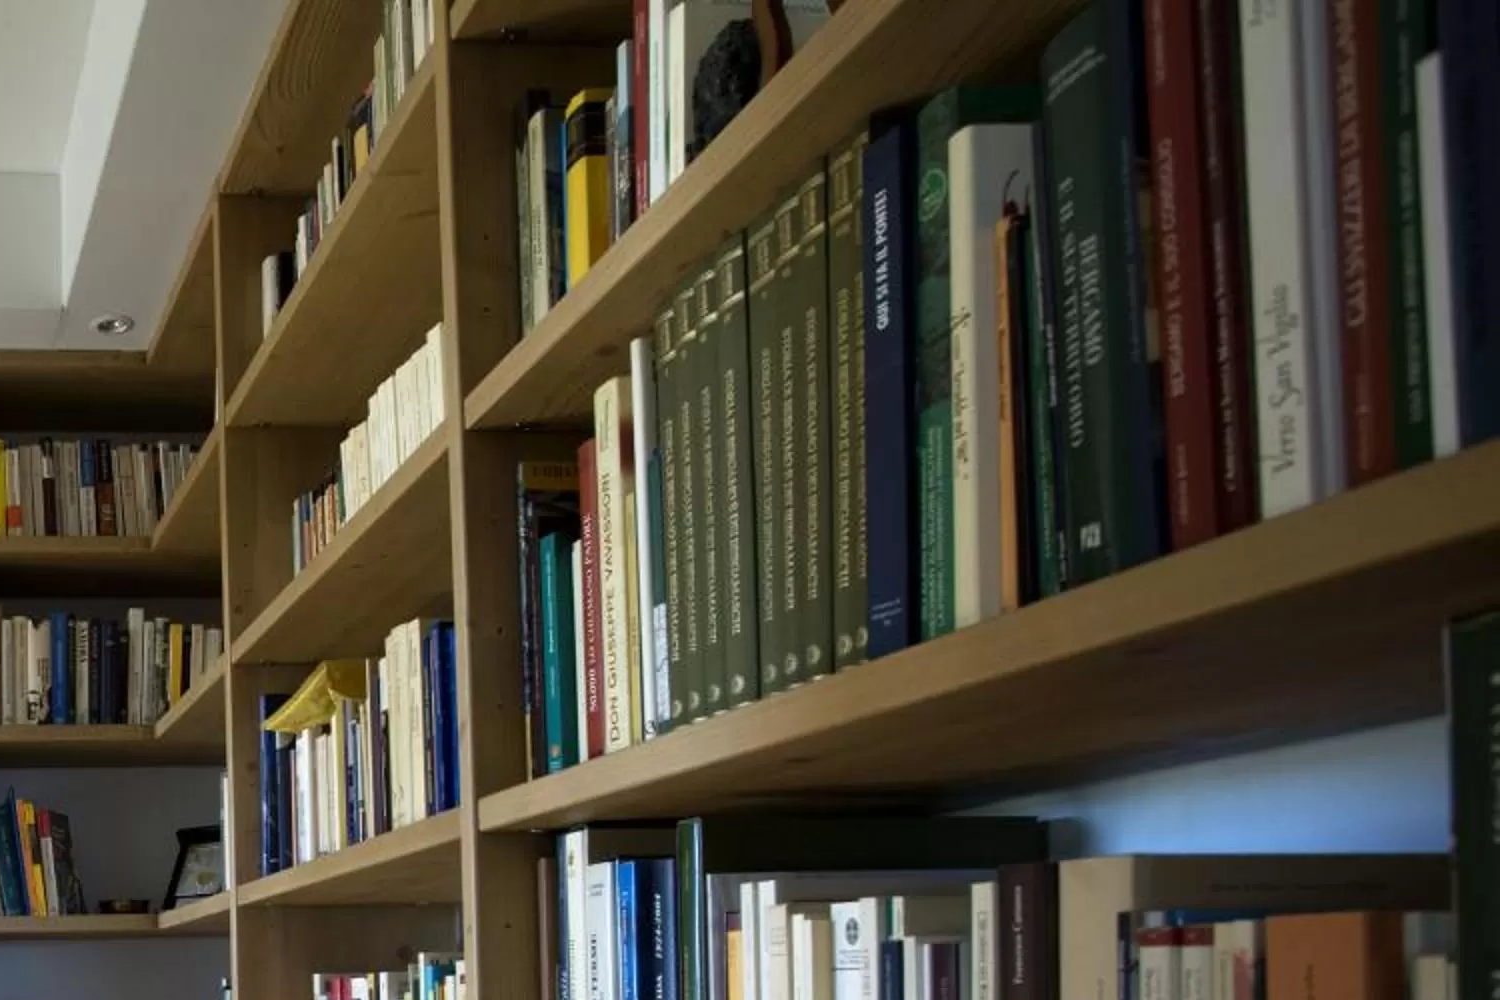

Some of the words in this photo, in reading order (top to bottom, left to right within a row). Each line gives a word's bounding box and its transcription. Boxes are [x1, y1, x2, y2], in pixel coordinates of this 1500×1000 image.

[1331, 0, 1357, 121] BERGAM
[1059, 200, 1075, 224] IL
[875, 246, 888, 262] IL
[875, 264, 888, 281] FA
[1061, 231, 1077, 287] SUO
[876, 282, 888, 298] SI
[876, 301, 889, 331] QUI
[1079, 234, 1103, 366] BERGAMO
[1256, 283, 1300, 358] Vigilio
[1063, 289, 1085, 448] TERRITORIO
[1268, 361, 1303, 409] San
[1255, 415, 1297, 474] Verso
[583, 512, 593, 566] PADRE
[601, 472, 613, 581] VAVASSORI
[606, 588, 617, 688] GIUSEPPE
[610, 697, 620, 741] DON
